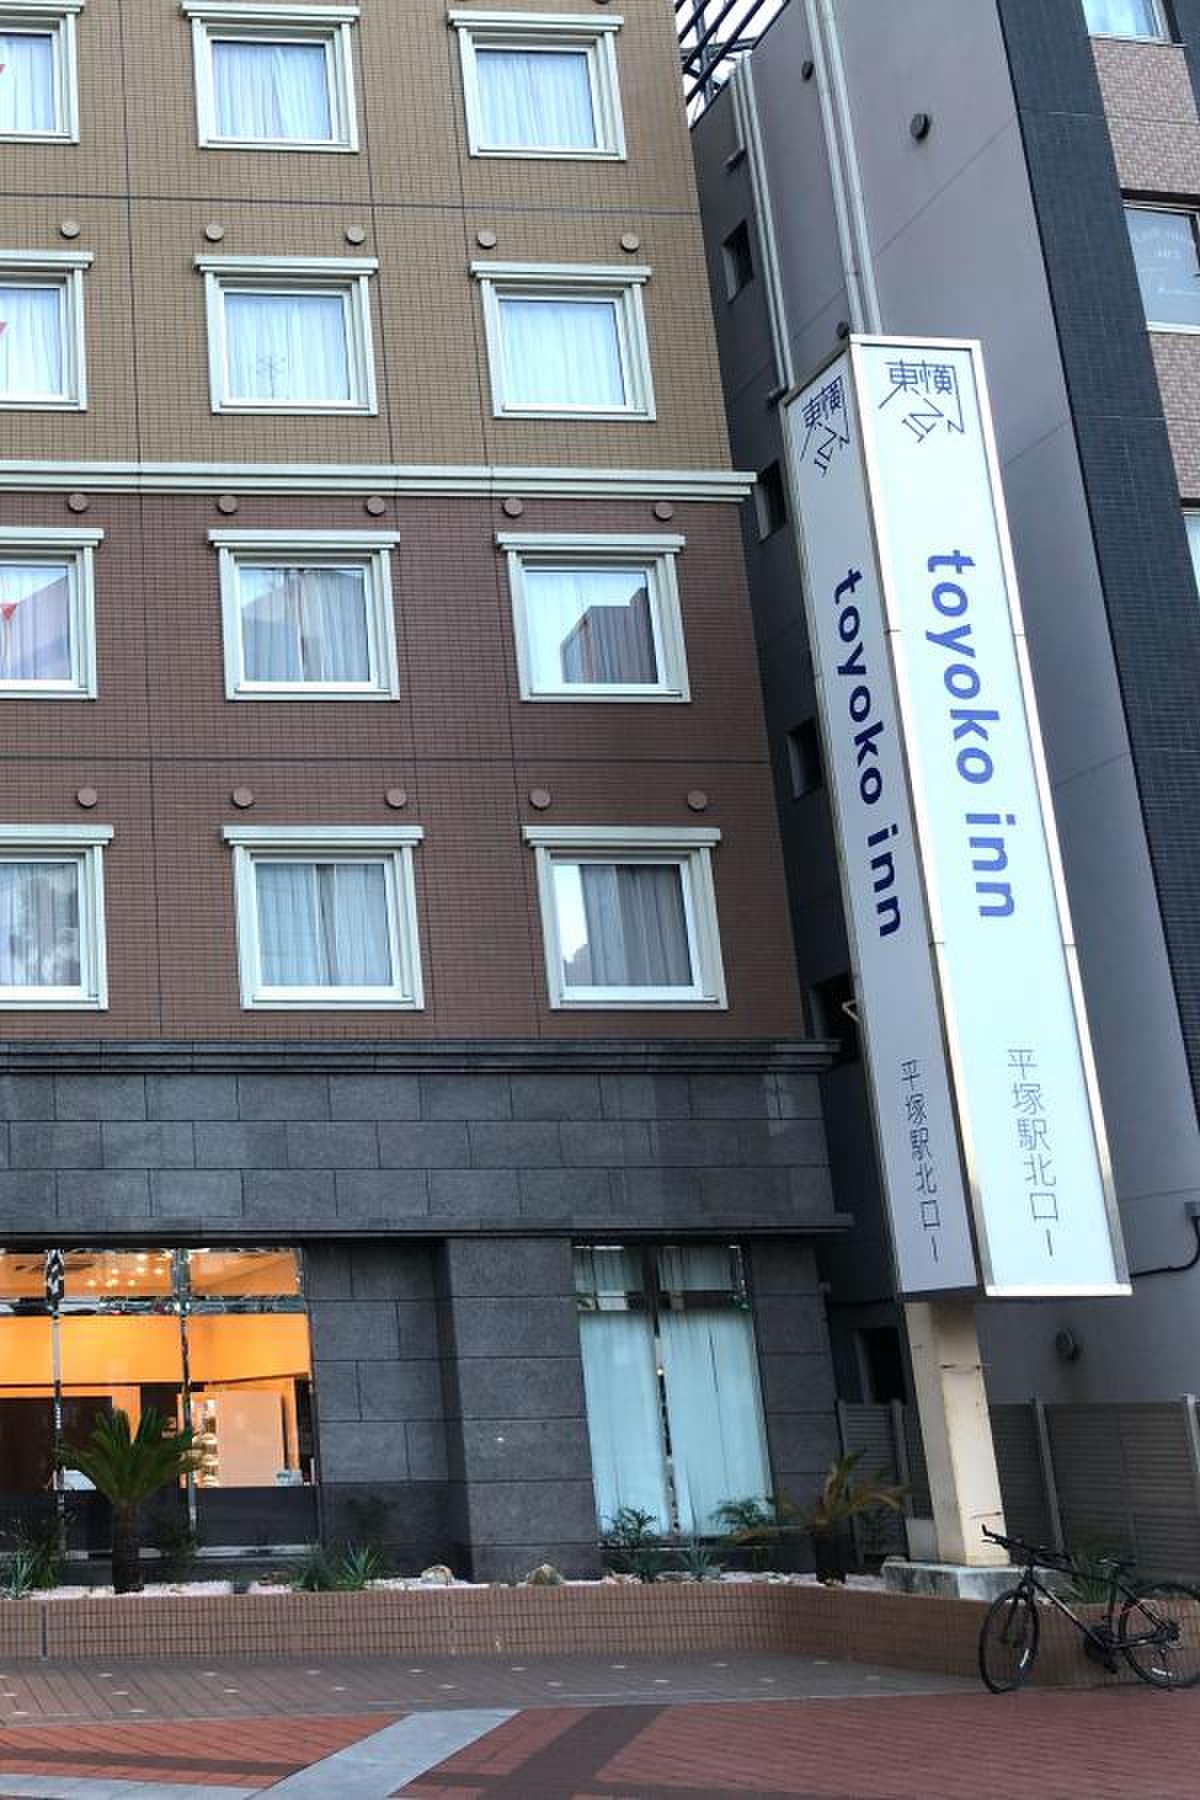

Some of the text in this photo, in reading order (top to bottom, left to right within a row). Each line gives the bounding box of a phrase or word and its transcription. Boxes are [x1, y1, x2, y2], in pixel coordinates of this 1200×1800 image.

[834, 568, 901, 937] toyoko inn
[924, 549, 1016, 917] toyoko inn
